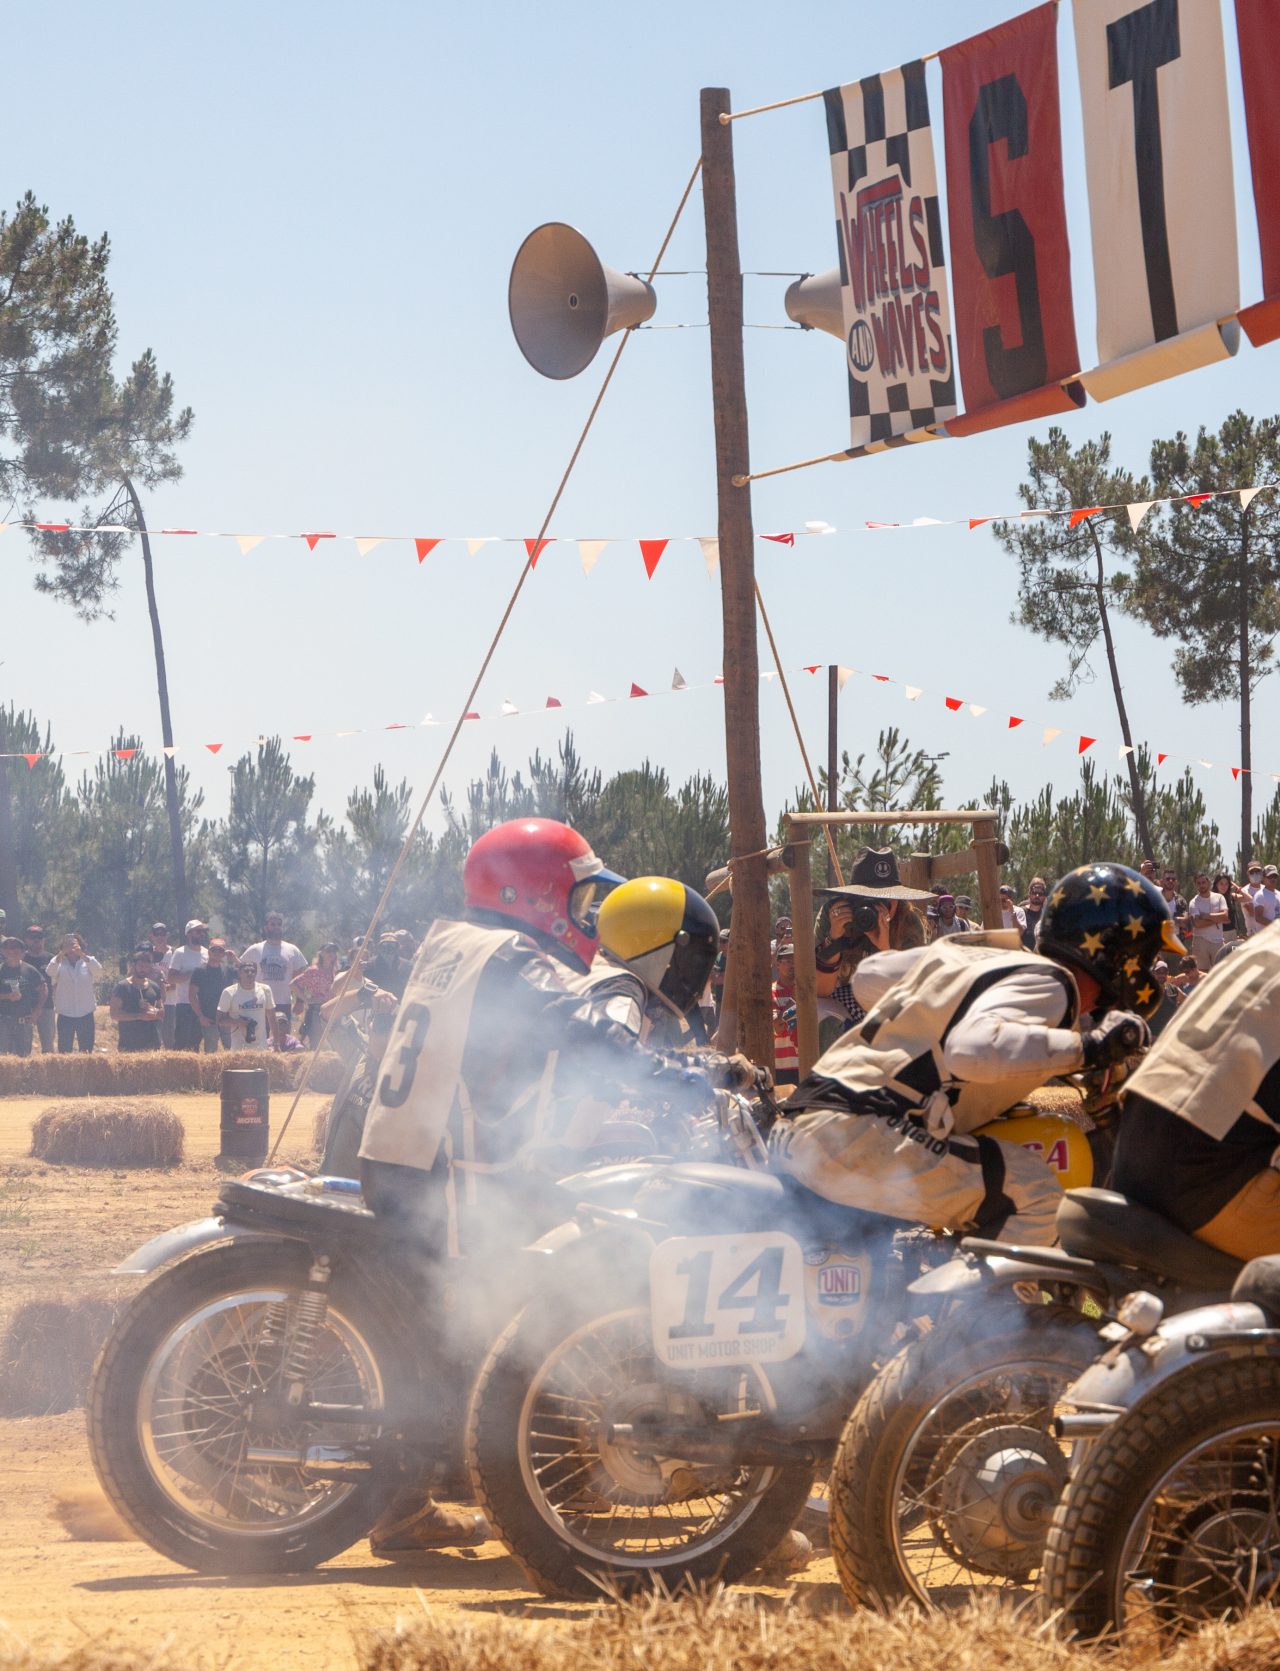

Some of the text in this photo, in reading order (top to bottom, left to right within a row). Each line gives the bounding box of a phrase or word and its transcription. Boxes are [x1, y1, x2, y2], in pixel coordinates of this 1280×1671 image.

[840, 174, 930, 314] WHEELS
[850, 290, 947, 380] AND WAVES
[379, 1002, 430, 1108] 3
[668, 1247, 790, 1339] 14
[822, 1271, 858, 1292] UNIT
[667, 1338, 776, 1361] UNIT MOTOR SHOP
